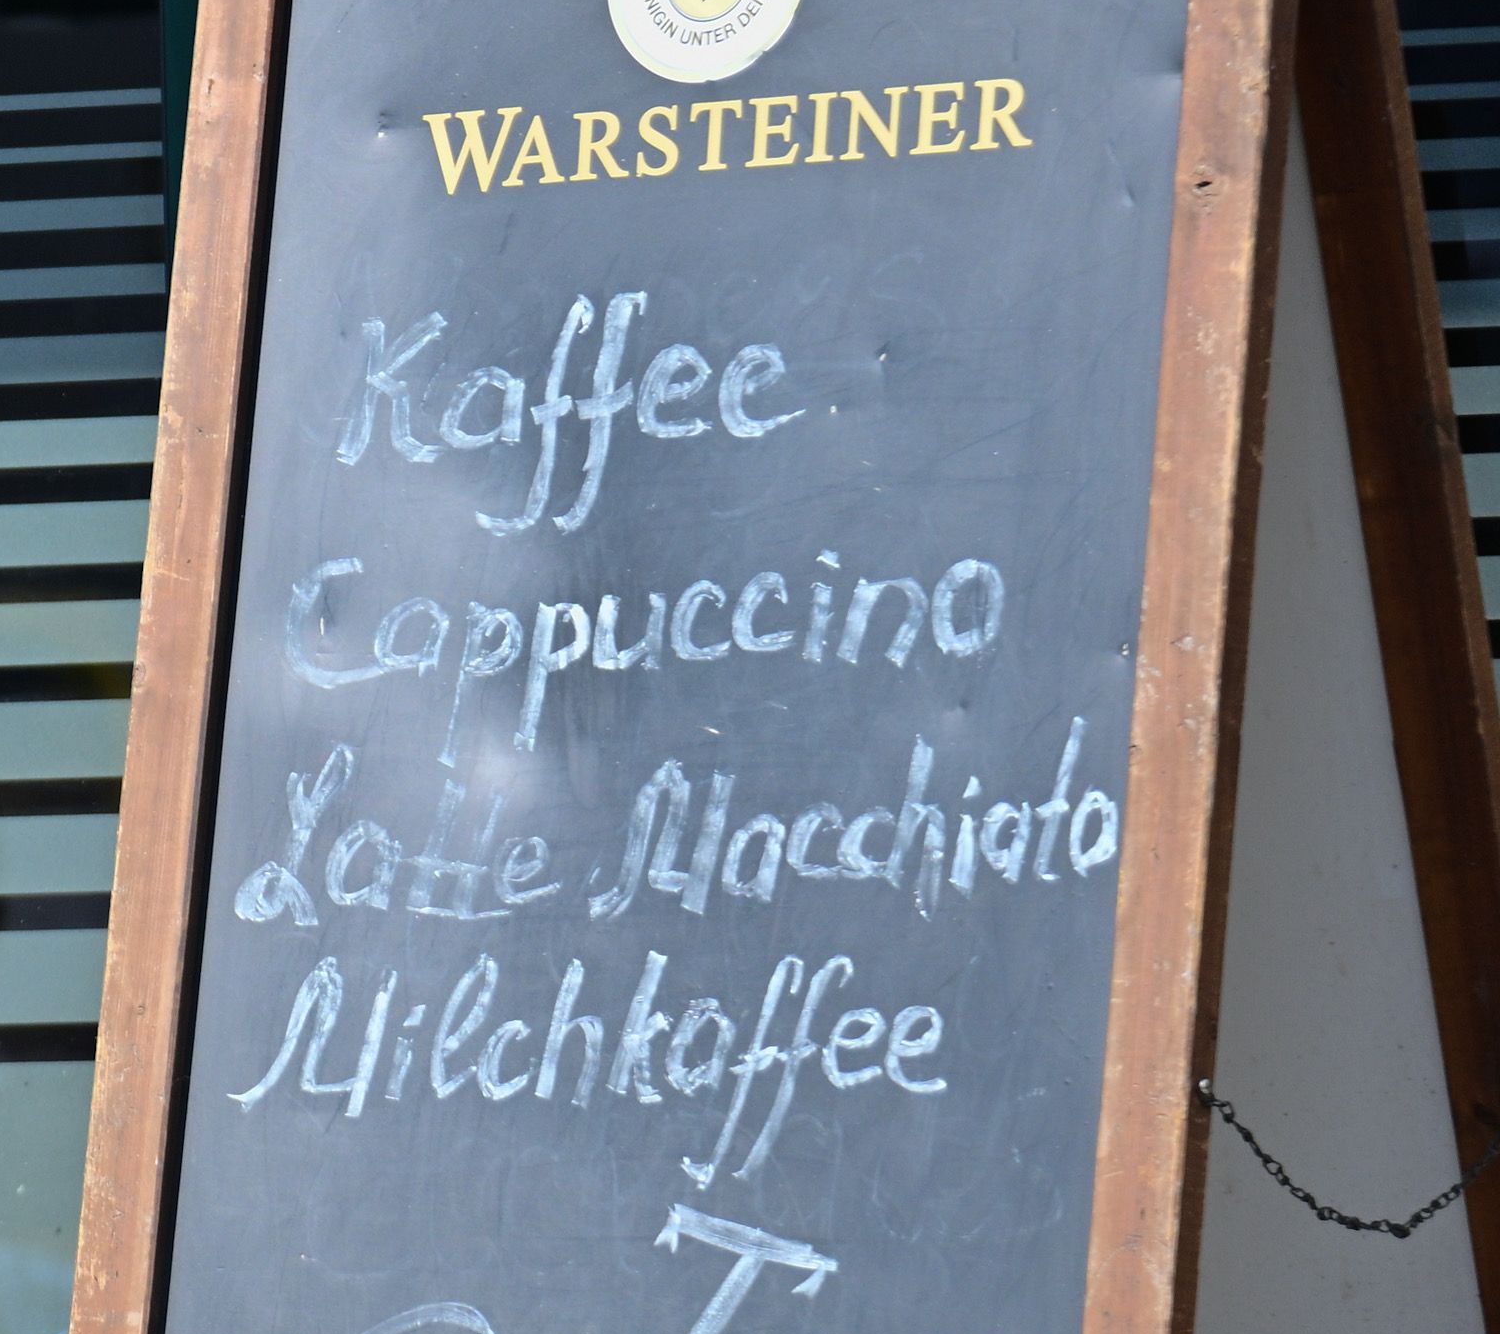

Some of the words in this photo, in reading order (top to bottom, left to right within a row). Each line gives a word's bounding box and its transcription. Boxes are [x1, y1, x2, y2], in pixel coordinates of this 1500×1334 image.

[422, 78, 1033, 195] WARSTEINER
[680, 23, 737, 46] UNTER
[337, 291, 806, 536] Kaffee
[286, 549, 1004, 767] Cappuccino
[234, 743, 564, 926] Latte
[589, 715, 1118, 922] Macchiato
[227, 950, 947, 1190] Milchkaffee
